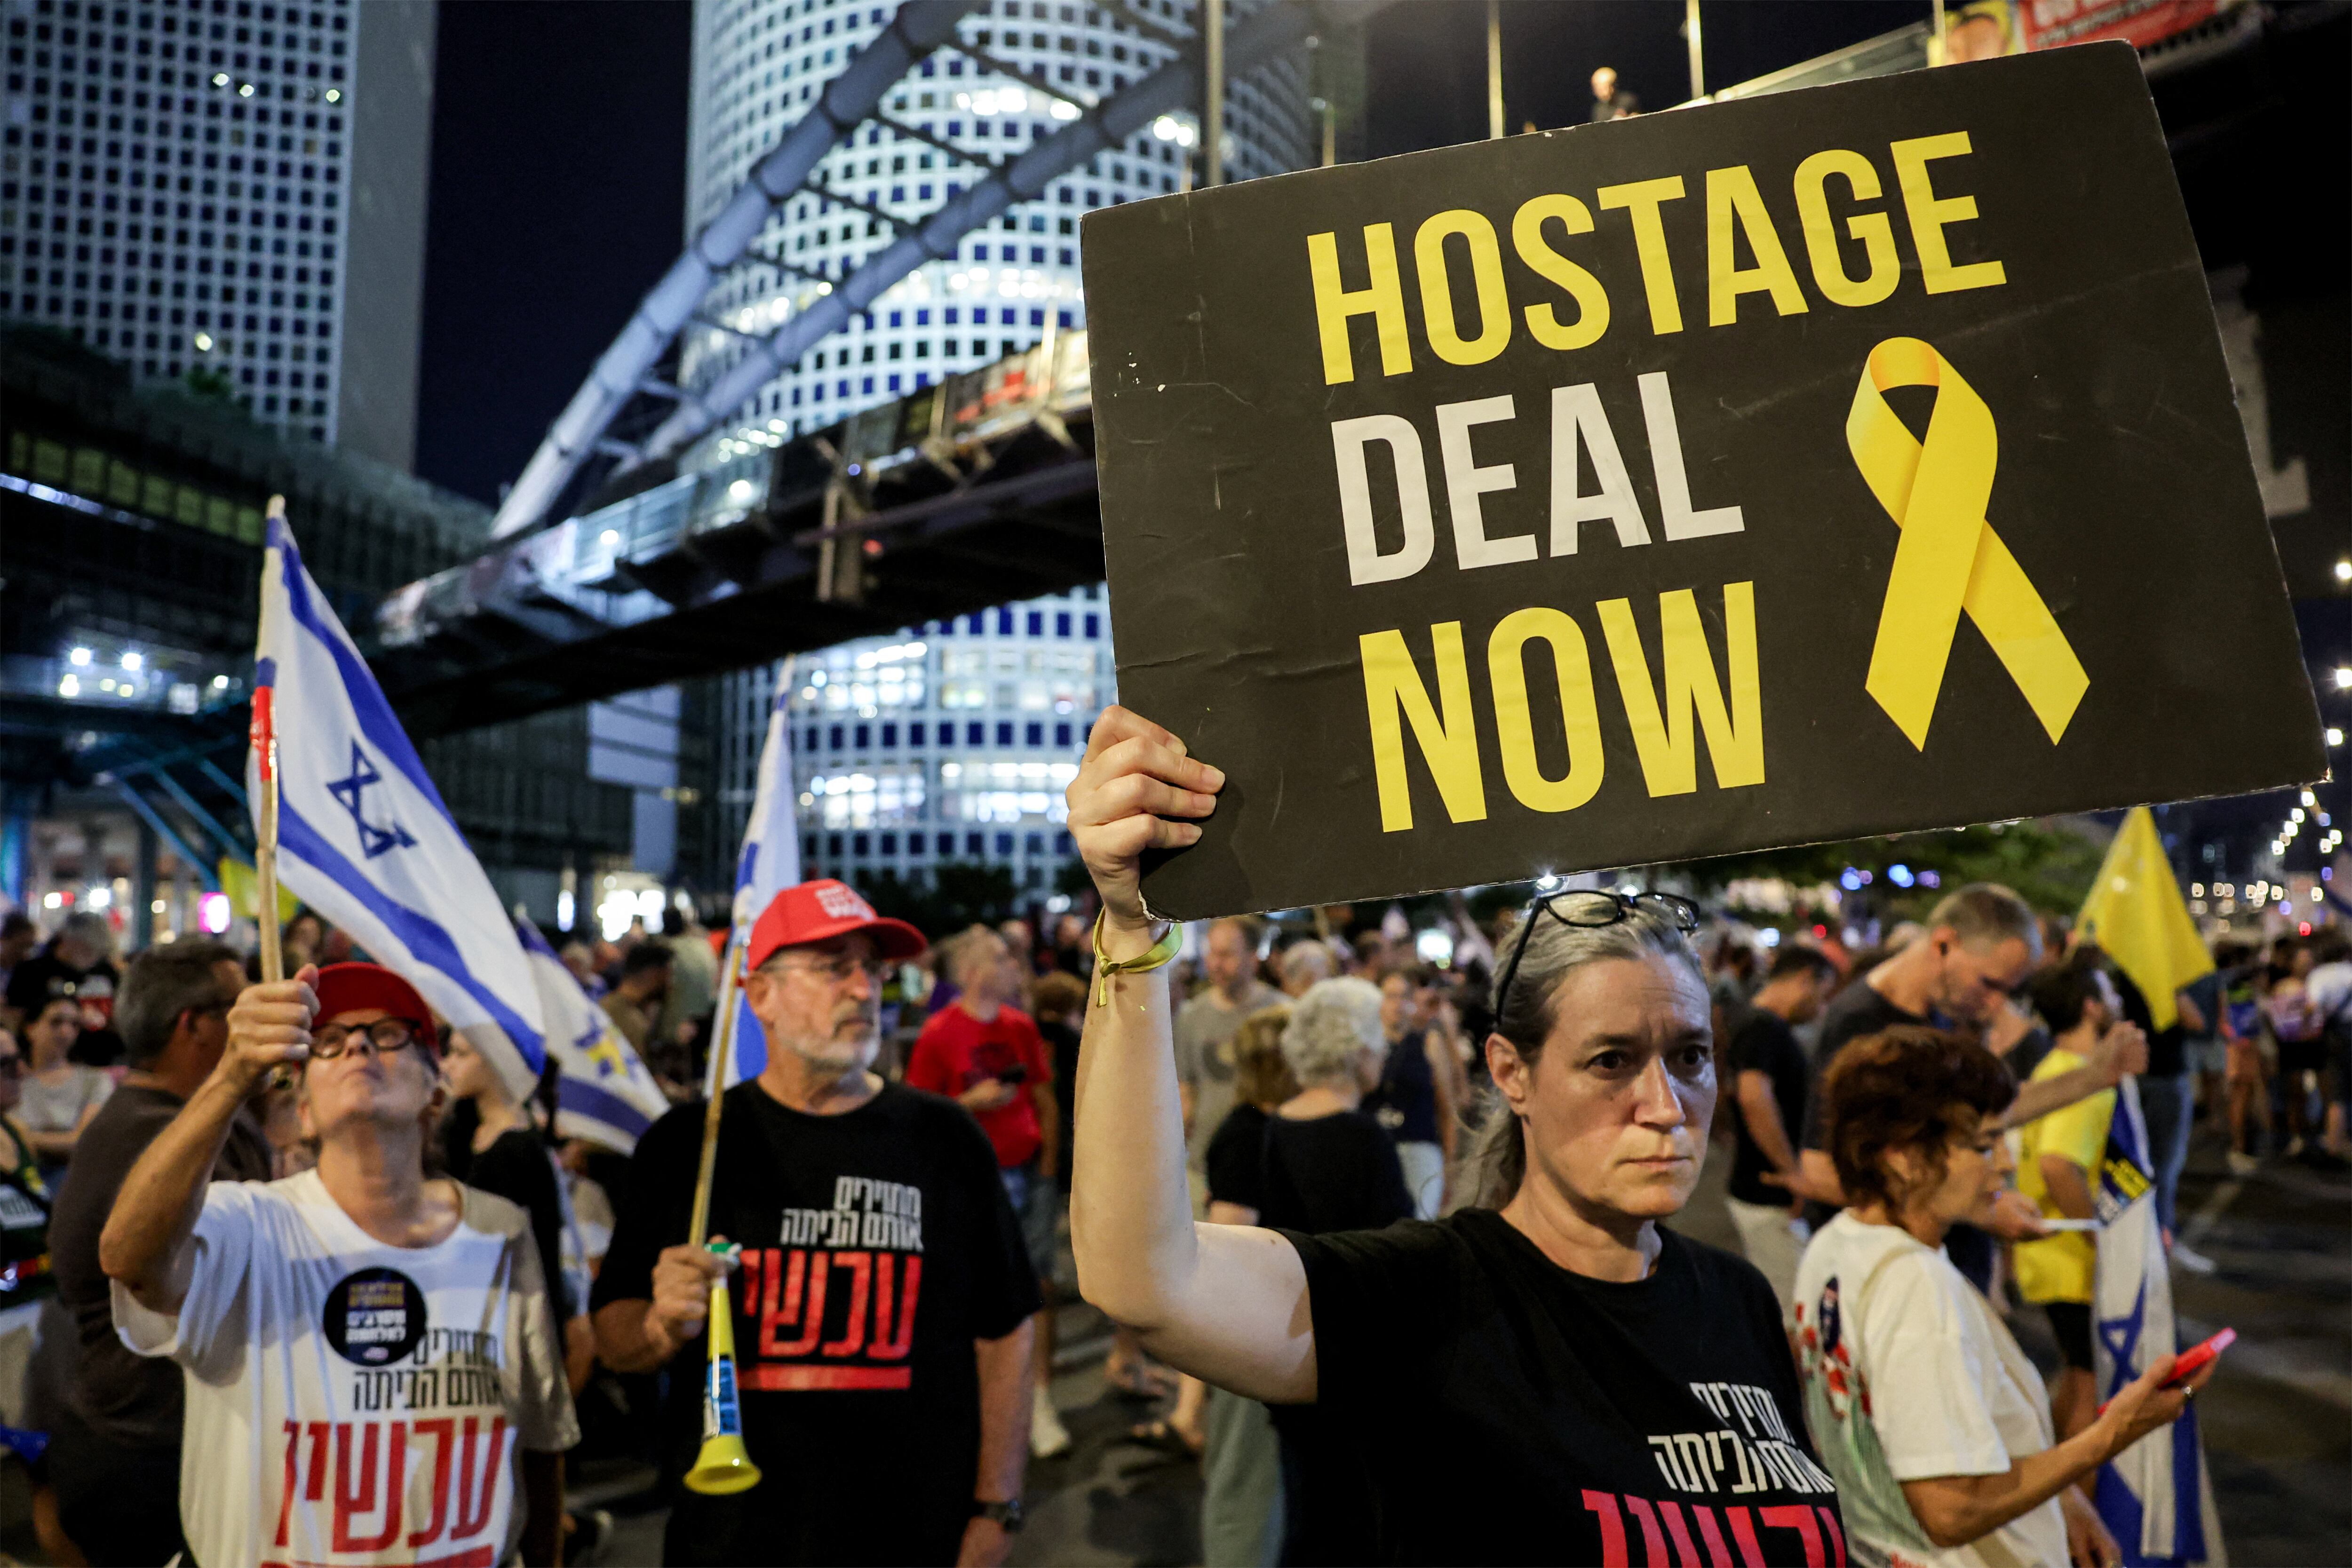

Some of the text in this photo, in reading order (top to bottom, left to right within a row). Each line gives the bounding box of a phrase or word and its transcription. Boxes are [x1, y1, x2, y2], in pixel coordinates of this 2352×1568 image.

[1307, 131, 2007, 385] HOSTAGE
[1331, 371, 1745, 586] DEAL
[1359, 581, 1765, 833] NOW
[780, 1208, 924, 1252] אותם הביתה
[739, 1248, 922, 1360] עכשי
[355, 1368, 504, 1410] אותם הביתה
[274, 1415, 506, 1554] עכשיו
